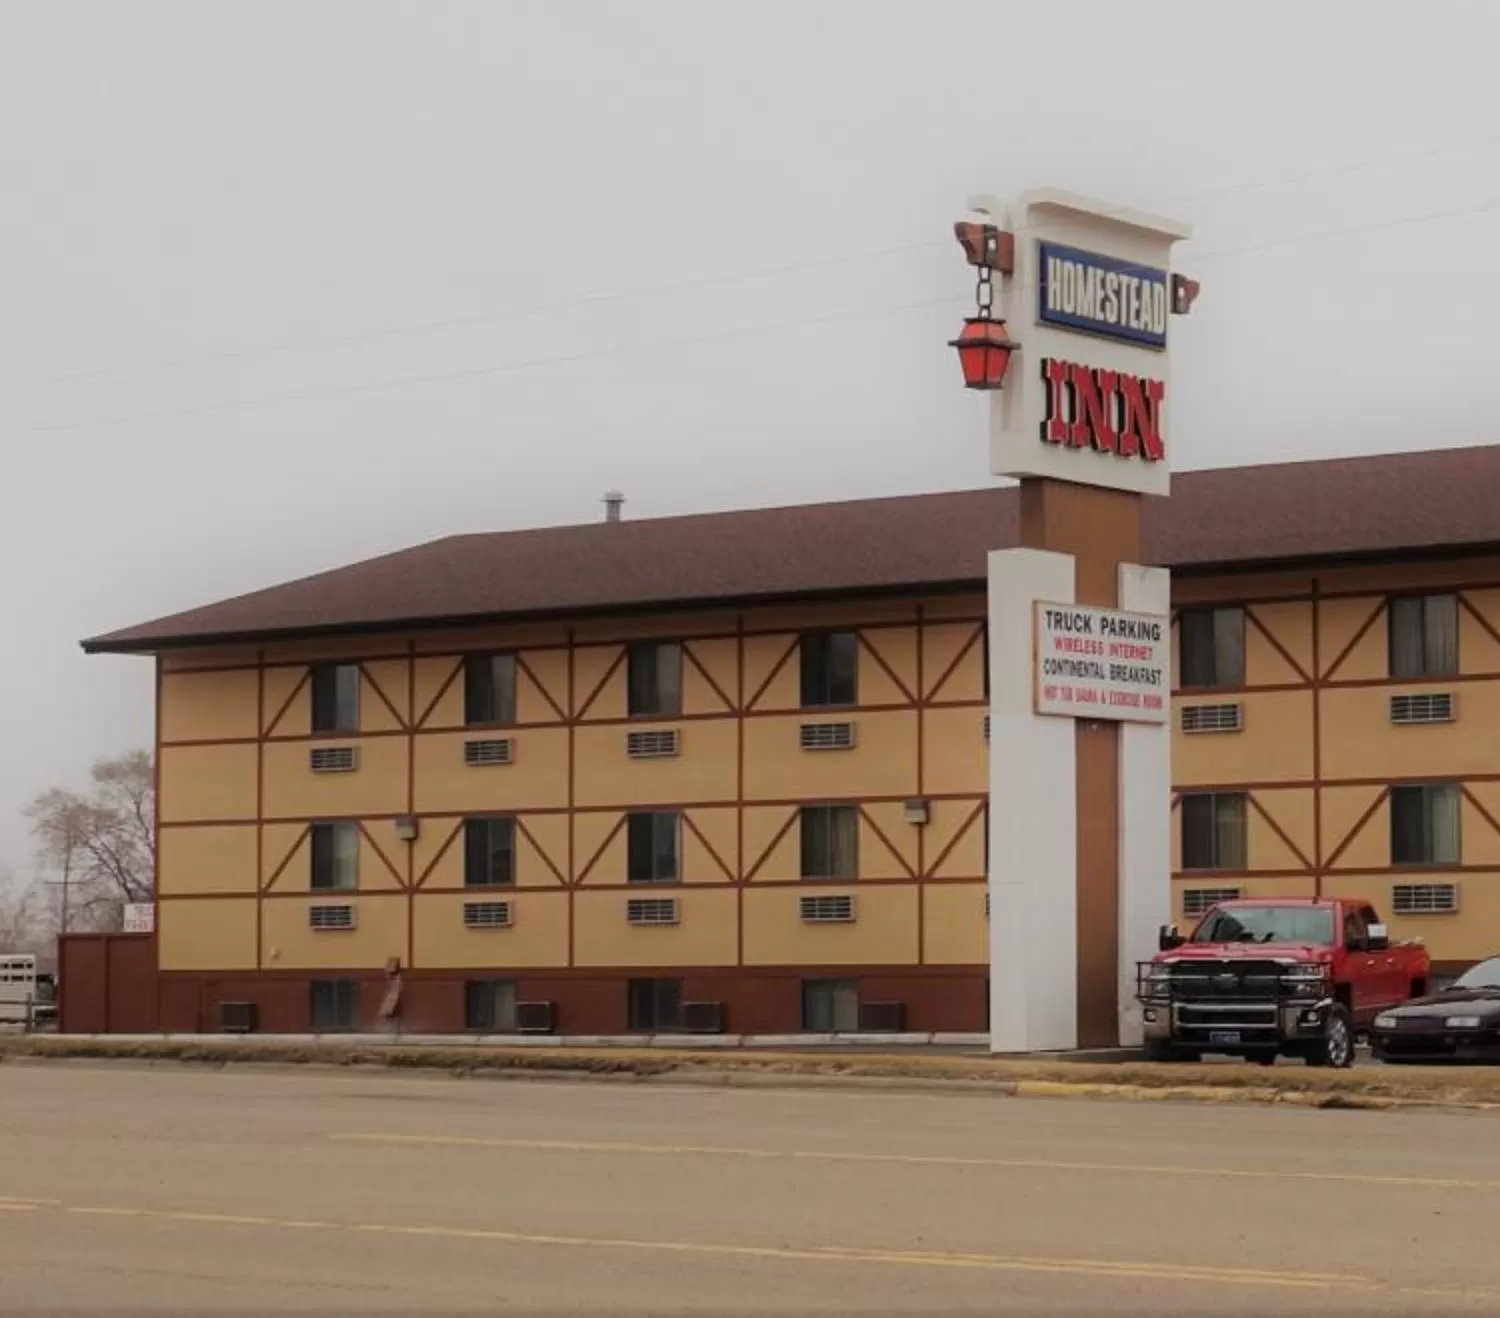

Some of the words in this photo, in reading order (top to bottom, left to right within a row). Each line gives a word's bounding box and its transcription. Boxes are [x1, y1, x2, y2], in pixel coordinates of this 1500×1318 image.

[1047, 255, 1165, 334] HOMESTEAD
[1041, 357, 1164, 461] INN
[1045, 610, 1092, 633] TRUCK
[1100, 616, 1161, 641] PARKING
[1054, 637, 1103, 655] WIRELESS
[1043, 658, 1105, 680] CONTINENTAL
[1109, 664, 1162, 685] BREAKFAST
